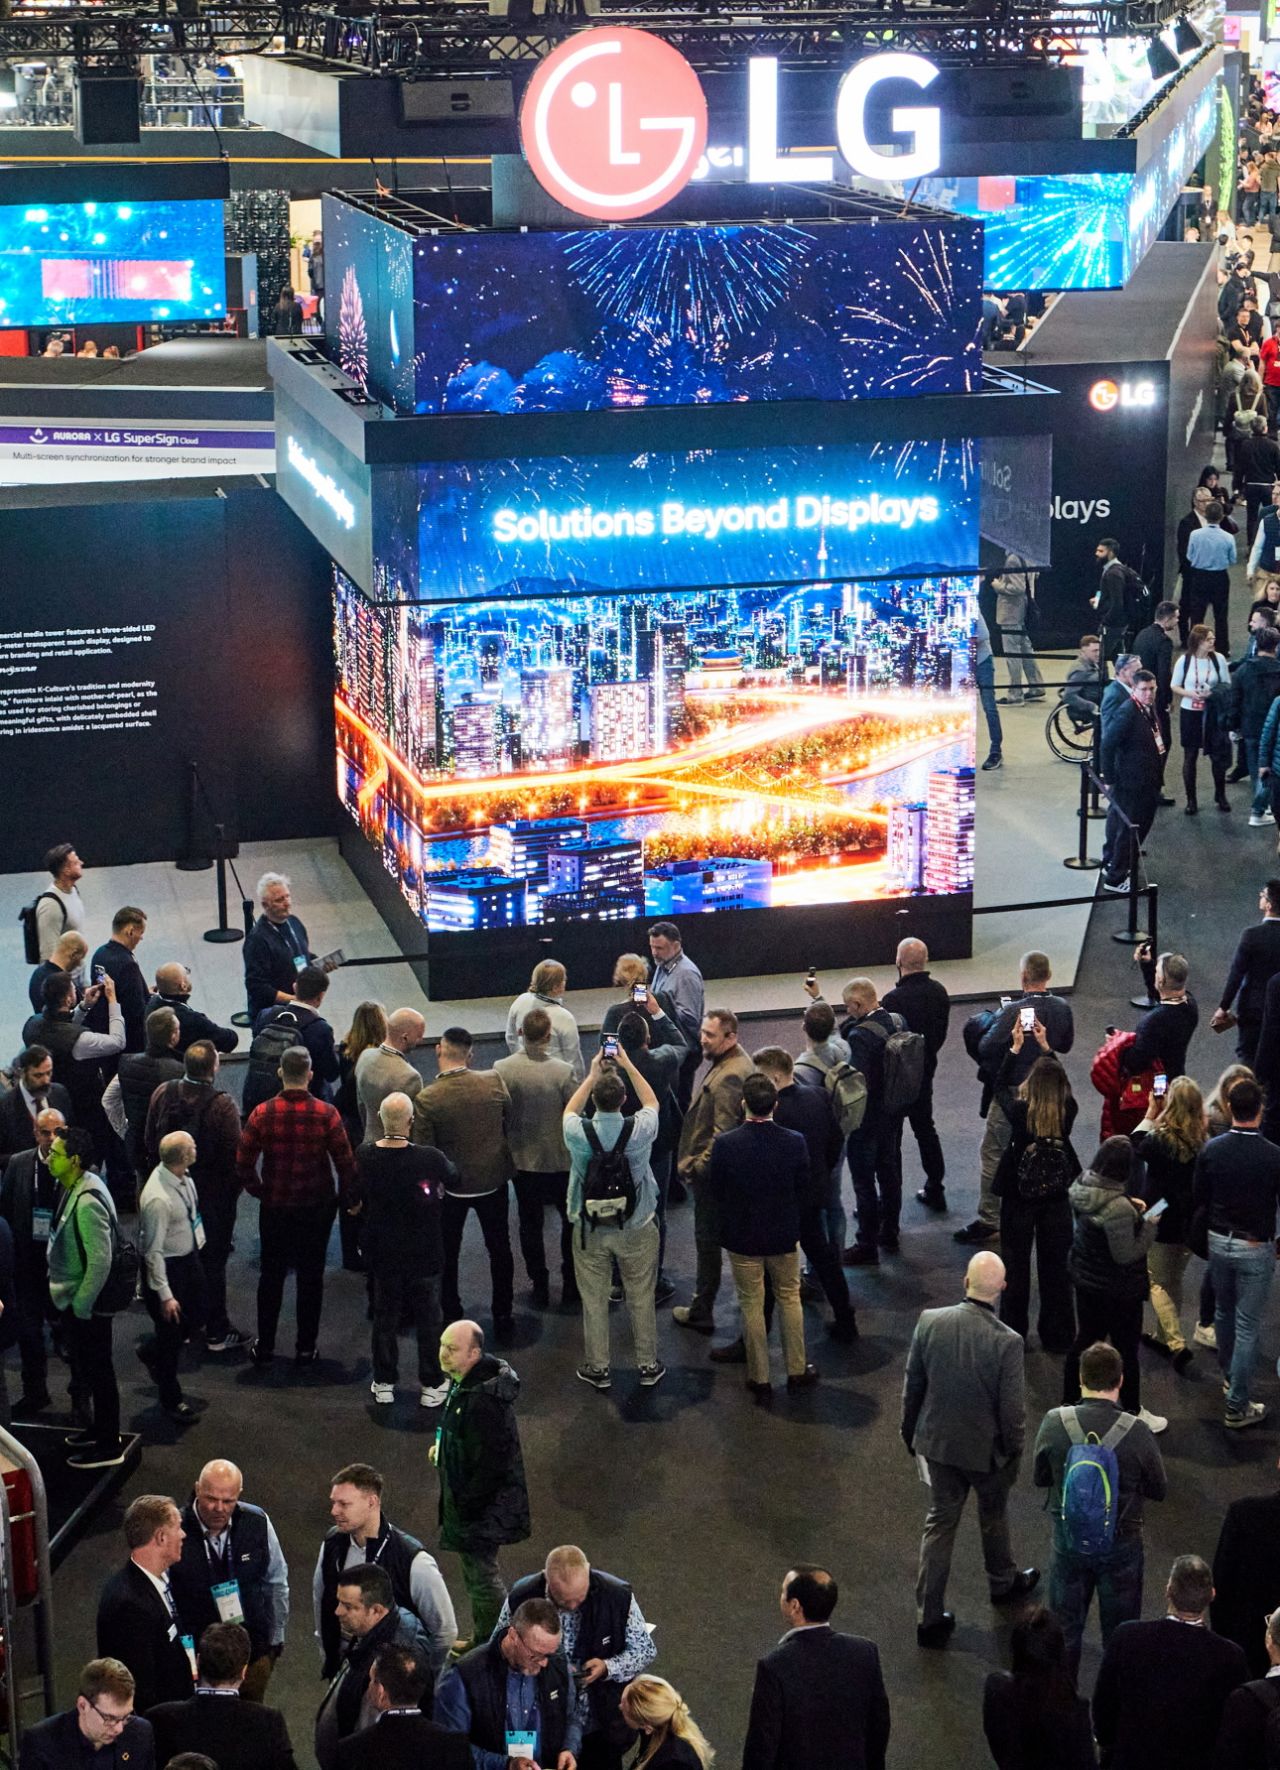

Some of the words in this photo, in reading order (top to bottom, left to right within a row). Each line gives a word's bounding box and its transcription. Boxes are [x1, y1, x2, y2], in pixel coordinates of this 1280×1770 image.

[749, 53, 941, 183] LG
[1121, 381, 1155, 406] LG
[53, 432, 91, 441] AURORA
[104, 432, 120, 443] LG
[123, 433, 179, 446] SuperSign
[180, 437, 199, 445] Cloud
[13, 452, 64, 461] Multi-screen
[65, 453, 130, 464] synchronization
[132, 454, 143, 463] for
[145, 456, 179, 465] stronger
[181, 456, 206, 464] brand
[208, 456, 237, 465] impact
[494, 508, 655, 542] Solutions
[662, 498, 788, 539] Beyond
[796, 493, 939, 531] Displays
[102, 625, 141, 634] three-sided
[26, 640, 65, 648] transparent
[86, 637, 111, 645] display,
[112, 635, 142, 644] designed
[10, 651, 40, 659] branding
[74, 648, 113, 656] application.
[0, 688, 36, 696] represents
[37, 685, 75, 693] K-Culture's
[76, 683, 106, 691] tradition
[121, 680, 155, 688] modernity
[81, 691, 135, 700] mother-of-pearl,
[63, 703, 95, 711] cherished
[96, 702, 132, 710] belongings
[36, 716, 55, 724] gifts,
[72, 713, 104, 721] delicately
[106, 711, 140, 719] embedded
[91, 722, 124, 730] lacquered
